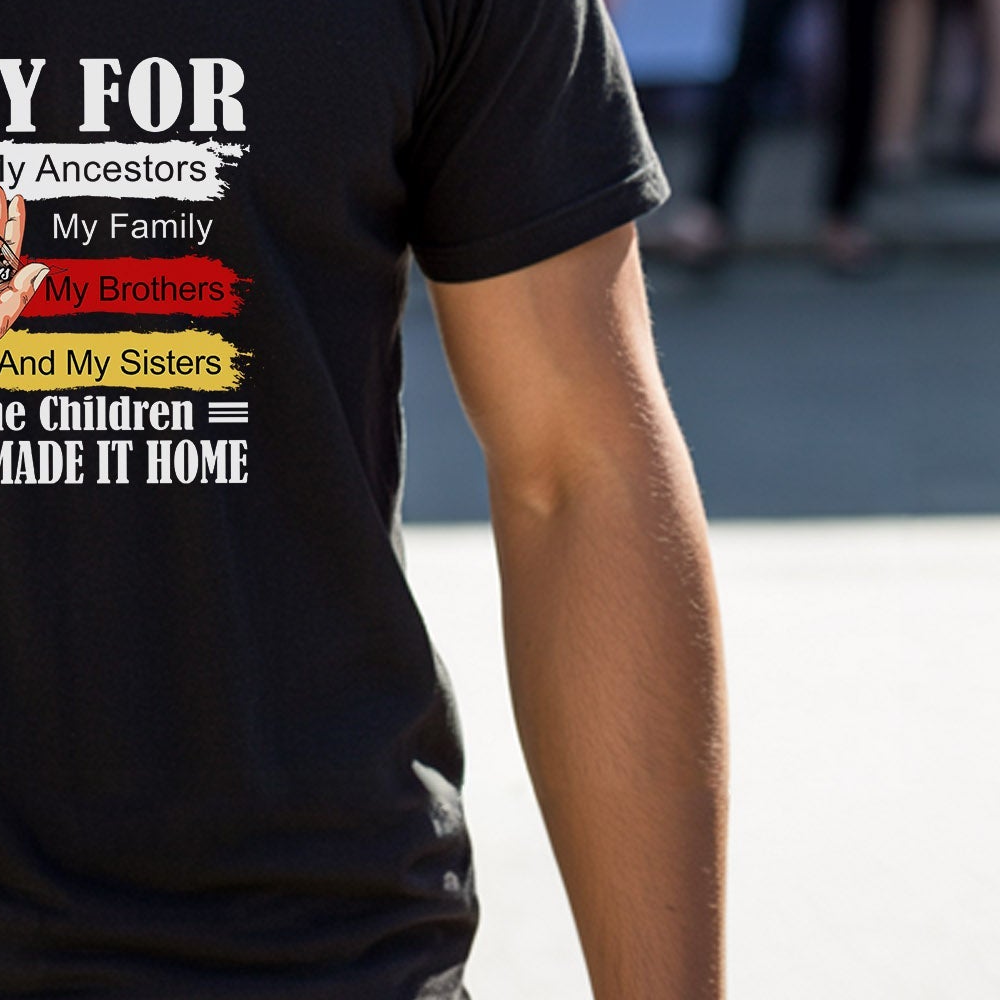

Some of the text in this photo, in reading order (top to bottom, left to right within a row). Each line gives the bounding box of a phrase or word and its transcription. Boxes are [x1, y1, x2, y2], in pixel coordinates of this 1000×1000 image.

[79, 57, 247, 133] FOR
[35, 154, 208, 183] Ancestors
[53, 212, 213, 246] My Family
[46, 275, 225, 308] My Brothers
[67, 349, 111, 382] My
[120, 348, 222, 377] Sisters
[39, 395, 194, 431] Children
[97, 440, 134, 484] IT
[147, 439, 249, 484] HOME
